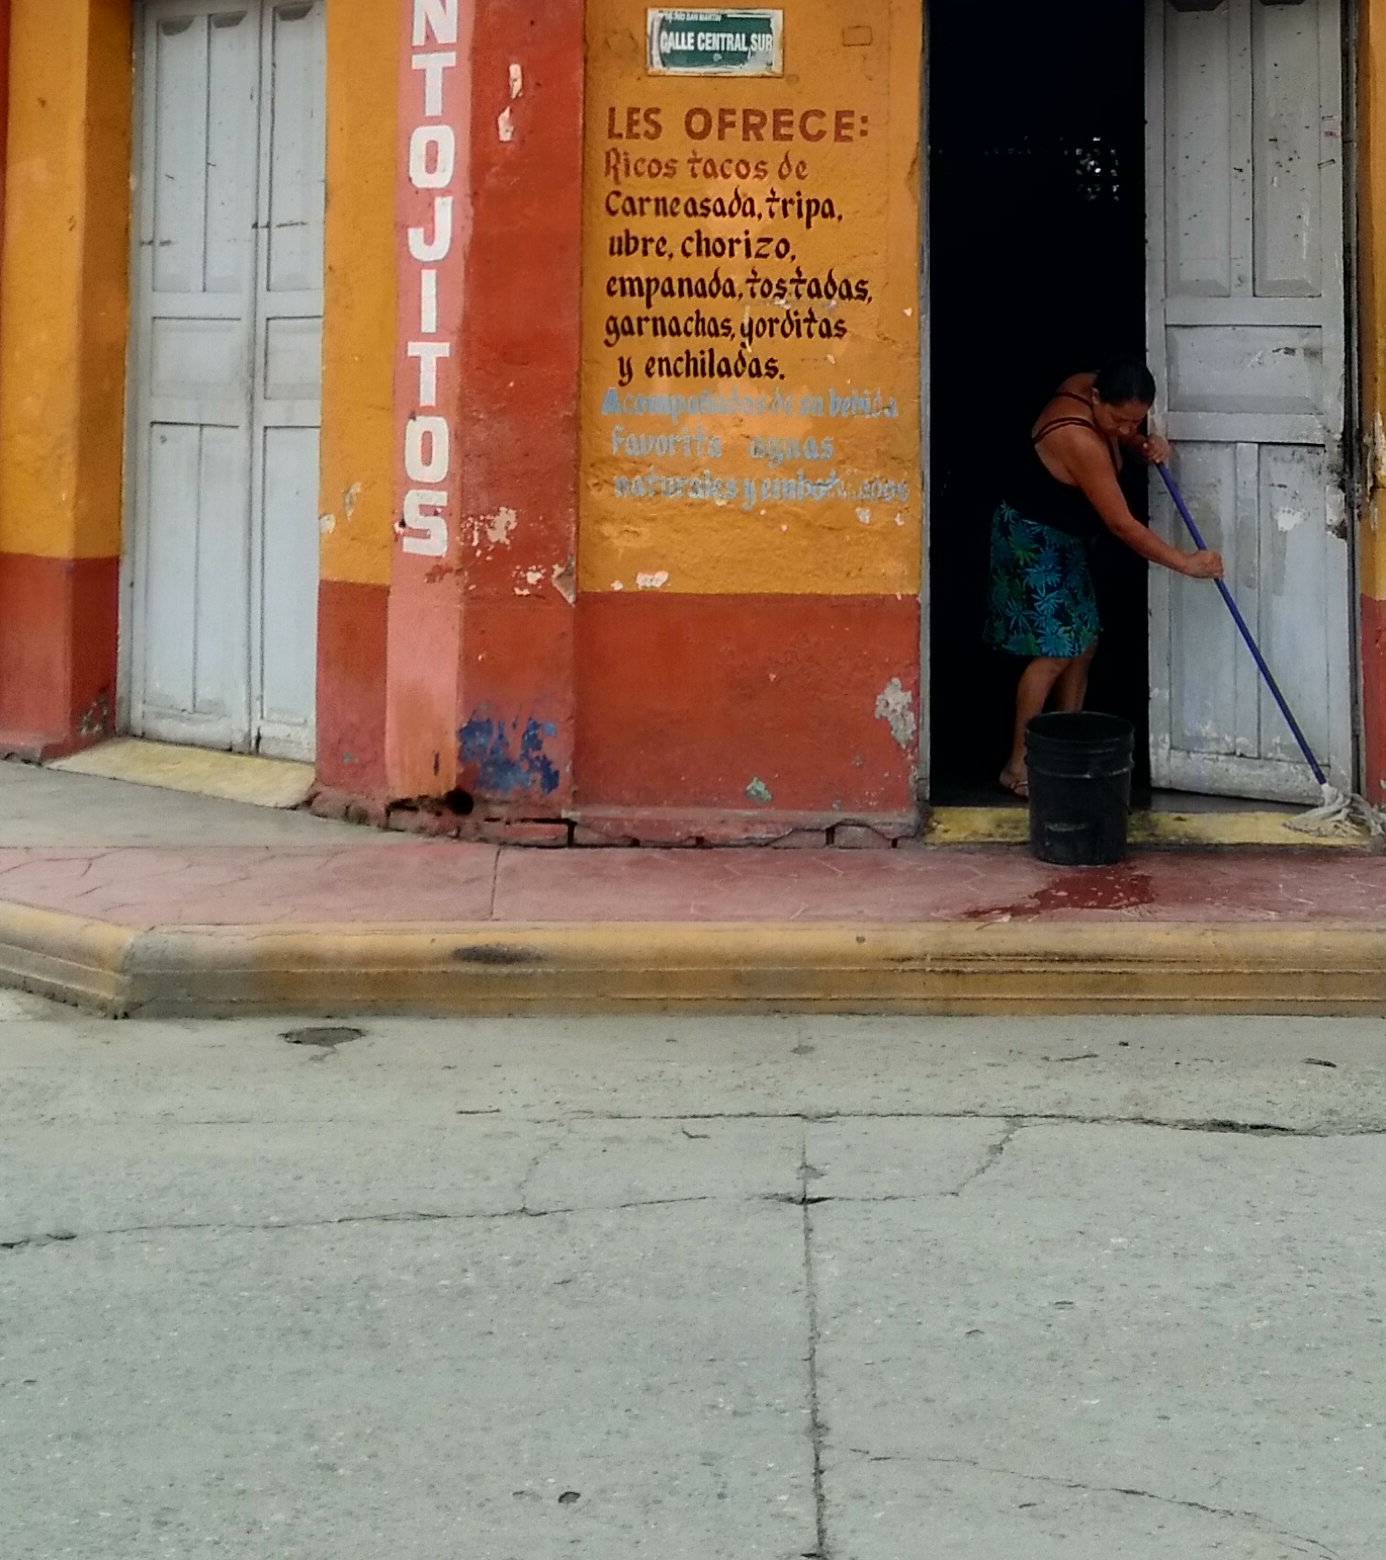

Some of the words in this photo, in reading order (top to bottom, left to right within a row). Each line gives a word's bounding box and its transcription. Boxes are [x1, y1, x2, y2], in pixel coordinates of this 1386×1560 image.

[660, 31, 694, 53] CALLE
[697, 32, 748, 52] CENTRAL
[750, 33, 773, 51] SUR
[607, 107, 663, 140] LES
[684, 107, 869, 143] OFRECE:
[604, 147, 678, 185] Ricos
[687, 149, 769, 180] tacos
[777, 150, 808, 180] de
[765, 187, 843, 229] tripa,
[608, 228, 674, 261] ubre,
[680, 228, 796, 263] chorizo,
[606, 267, 743, 309] empanada,
[745, 266, 873, 304] tostadas,
[603, 309, 736, 348] garnachas,
[740, 307, 848, 348] gorditas
[618, 355, 634, 387] y
[644, 348, 785, 380] enchiladas.
[742, 479, 758, 511] y
